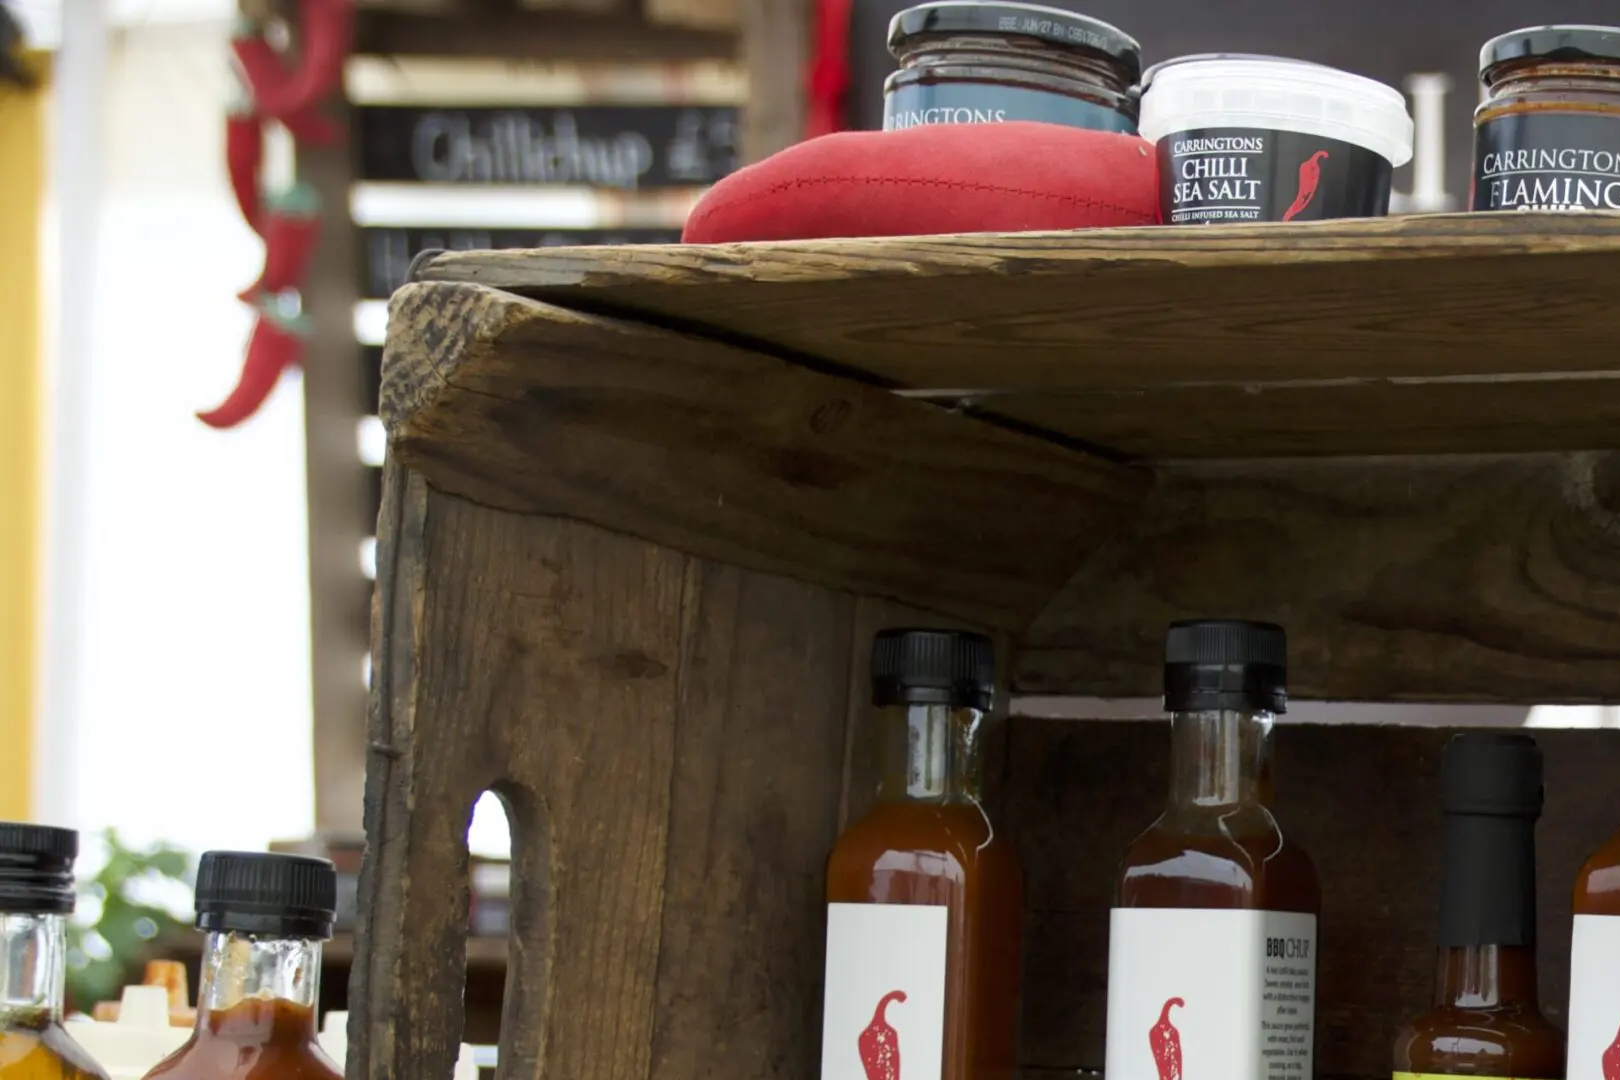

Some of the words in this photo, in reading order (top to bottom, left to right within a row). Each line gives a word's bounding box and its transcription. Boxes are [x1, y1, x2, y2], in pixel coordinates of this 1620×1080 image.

[1174, 137, 1263, 154] CARRINGTONS
[1182, 157, 1248, 179] CHILLI
[1173, 181, 1203, 203] SEA
[1208, 180, 1261, 201] SALT
[1224, 211, 1238, 219] SEA
[1240, 211, 1259, 219] SALT
